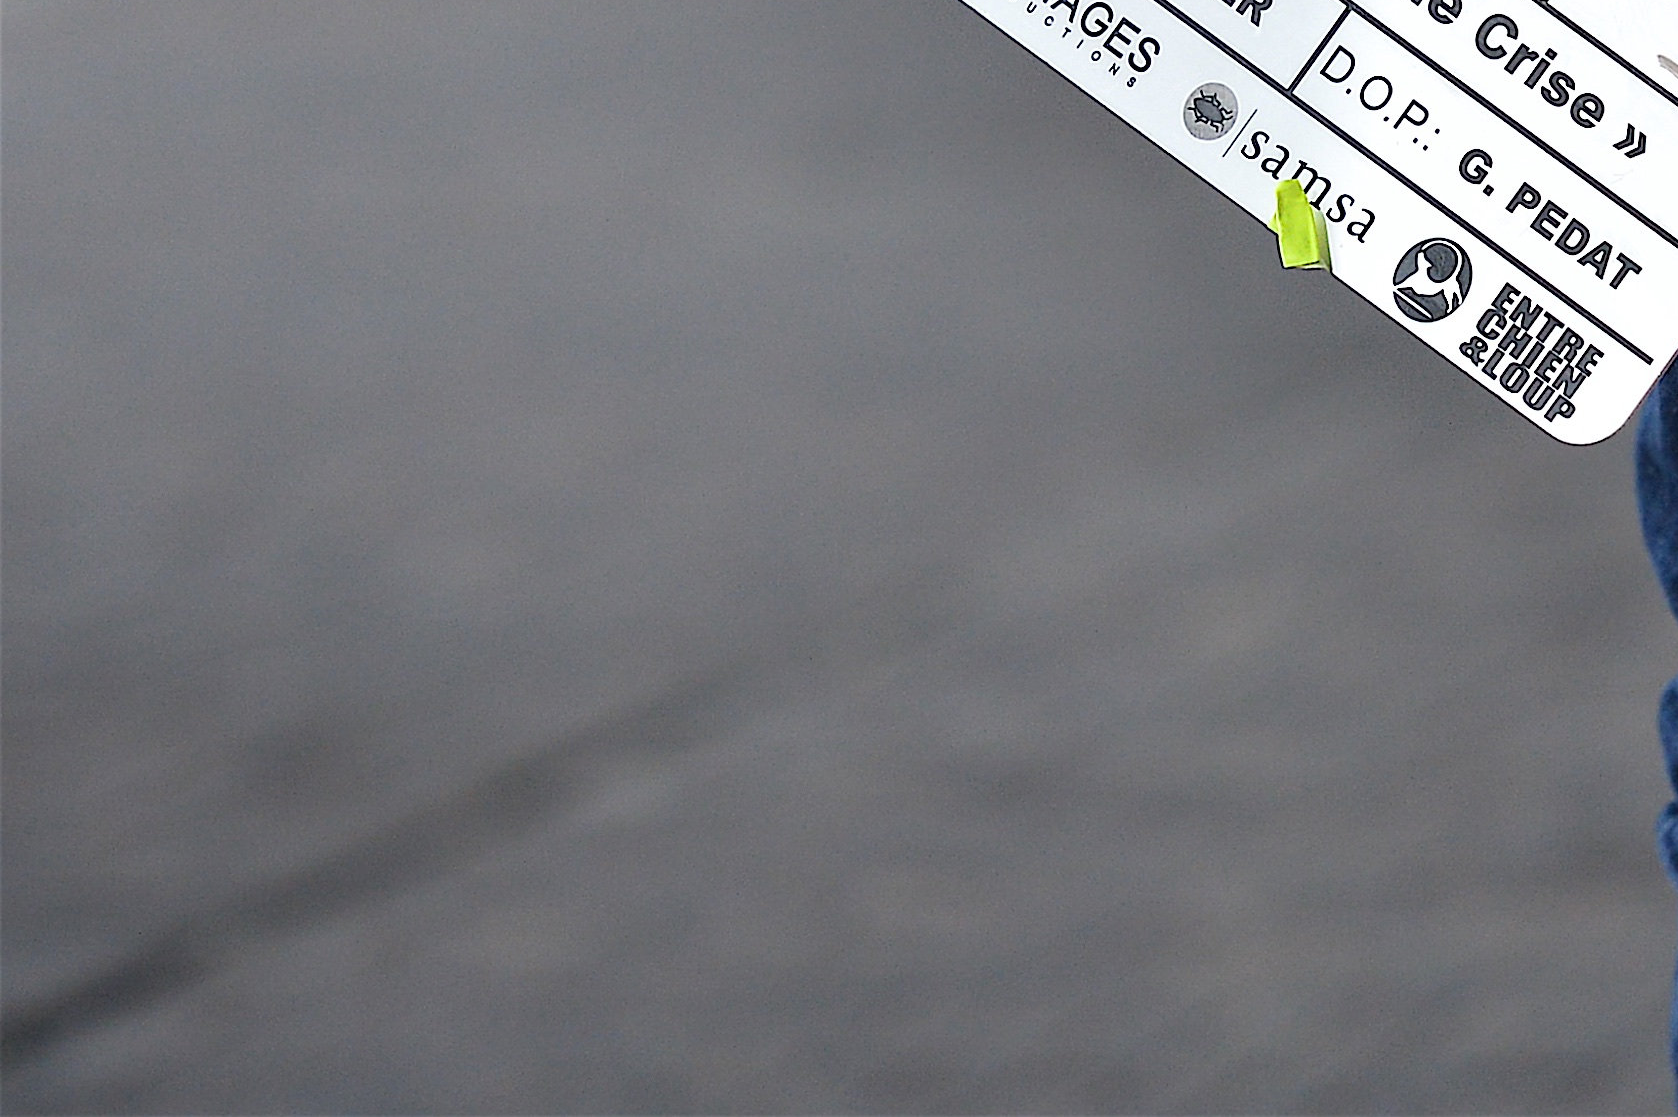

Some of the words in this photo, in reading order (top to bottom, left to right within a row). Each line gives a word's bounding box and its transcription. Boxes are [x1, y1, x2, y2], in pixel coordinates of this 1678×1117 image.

[1475, 13, 1605, 129] Crise
[1241, 131, 1376, 243] samsa
[1319, 45, 1442, 152] D.O.P.:
[1459, 148, 1494, 197] G.
[1505, 182, 1643, 291] PEDAT
[1459, 334, 1576, 423] &LOUP
[1476, 307, 1586, 400] CHIEN
[1491, 282, 1605, 379] ENTRE
